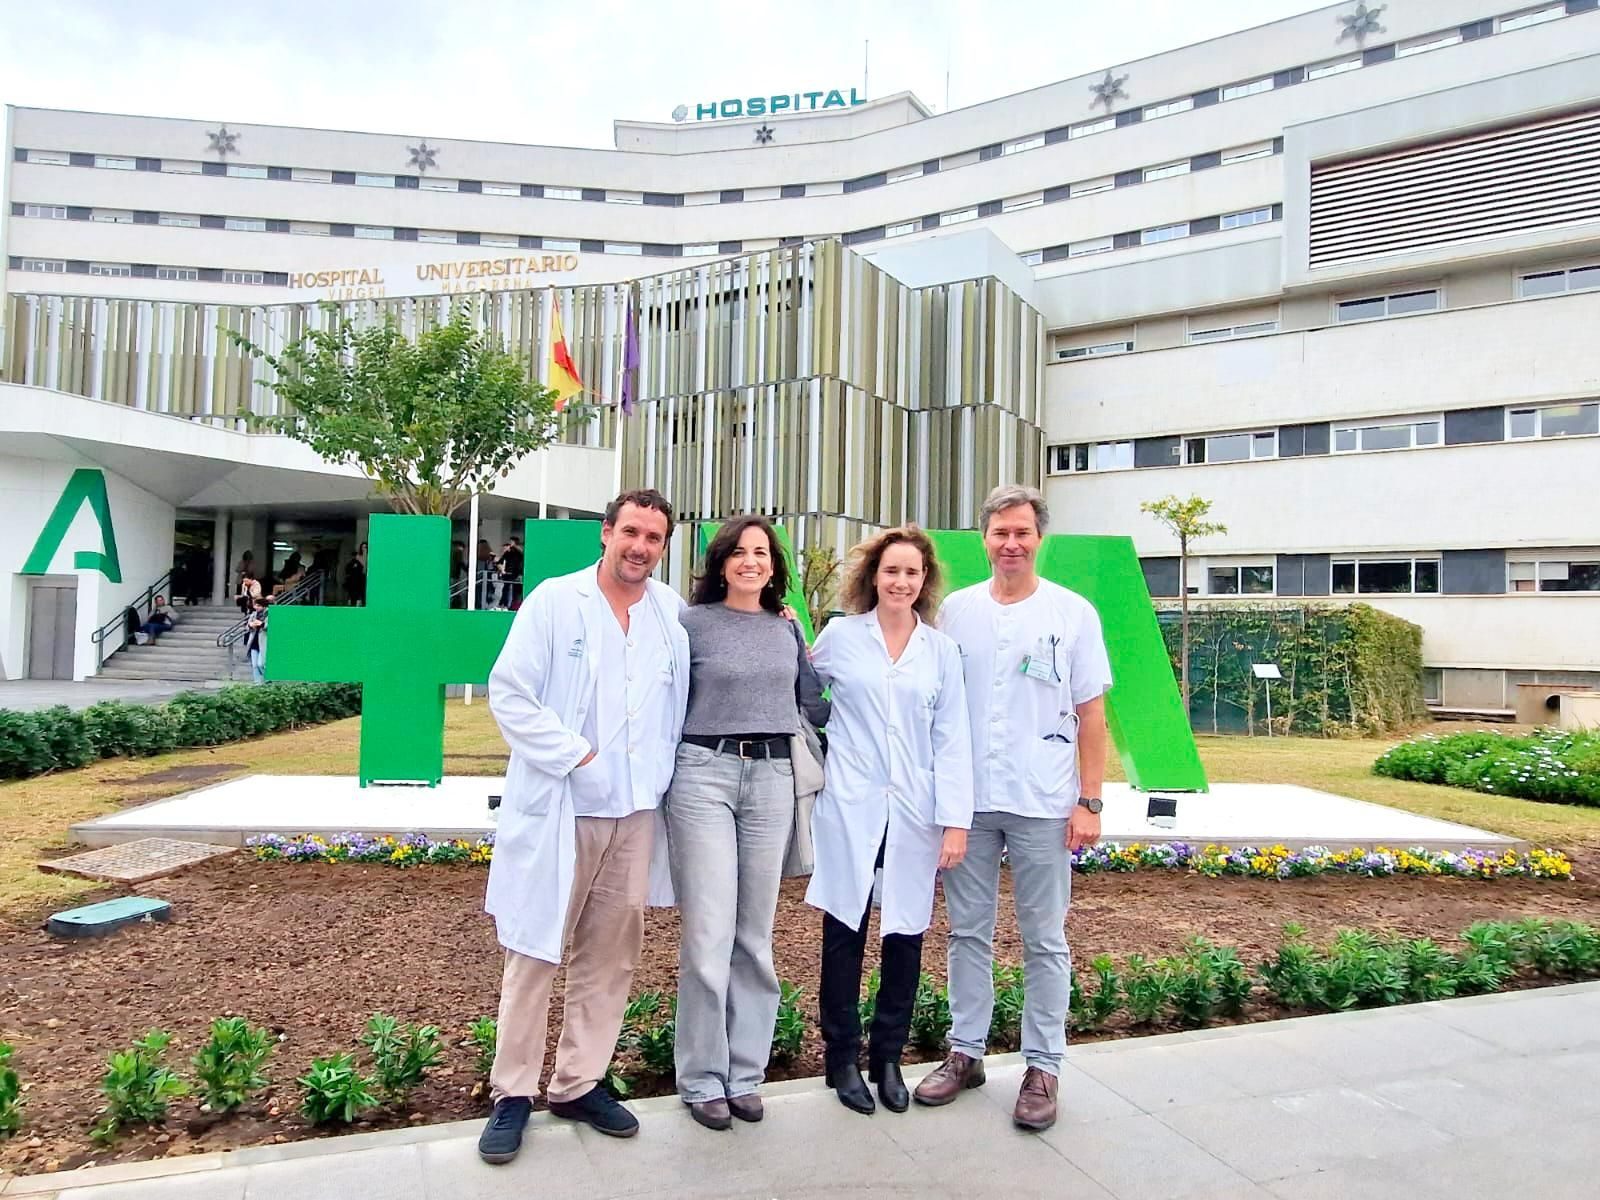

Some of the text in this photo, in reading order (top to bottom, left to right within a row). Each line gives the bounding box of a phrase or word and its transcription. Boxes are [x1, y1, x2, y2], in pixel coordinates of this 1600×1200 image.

[696, 88, 867, 120] HOSPITAL
[288, 254, 579, 289] HOSPITAL UNIVERSITARIO
[328, 286, 385, 300] VIRGEN
